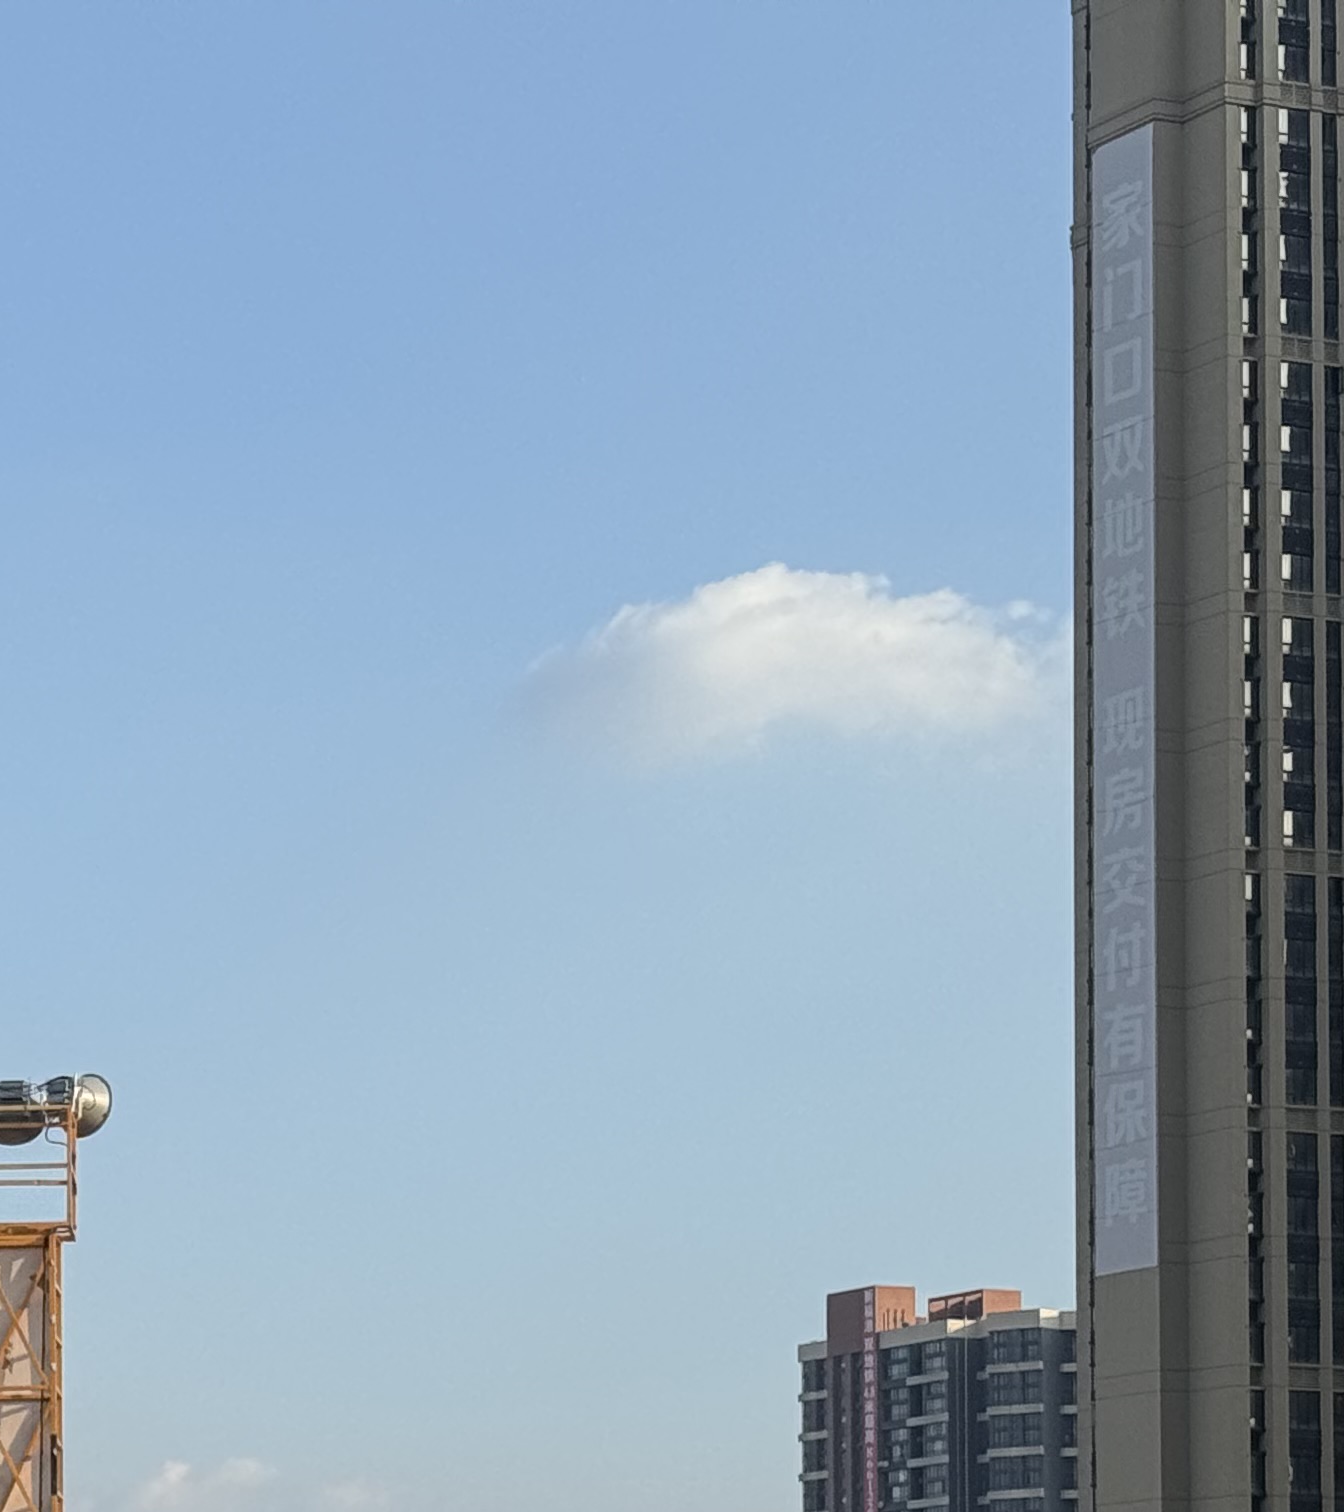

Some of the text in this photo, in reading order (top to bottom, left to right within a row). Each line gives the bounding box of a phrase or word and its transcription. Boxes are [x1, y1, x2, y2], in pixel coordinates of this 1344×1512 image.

[1100, 180, 1148, 1230] 家门口双地铁 现房交付有保障
